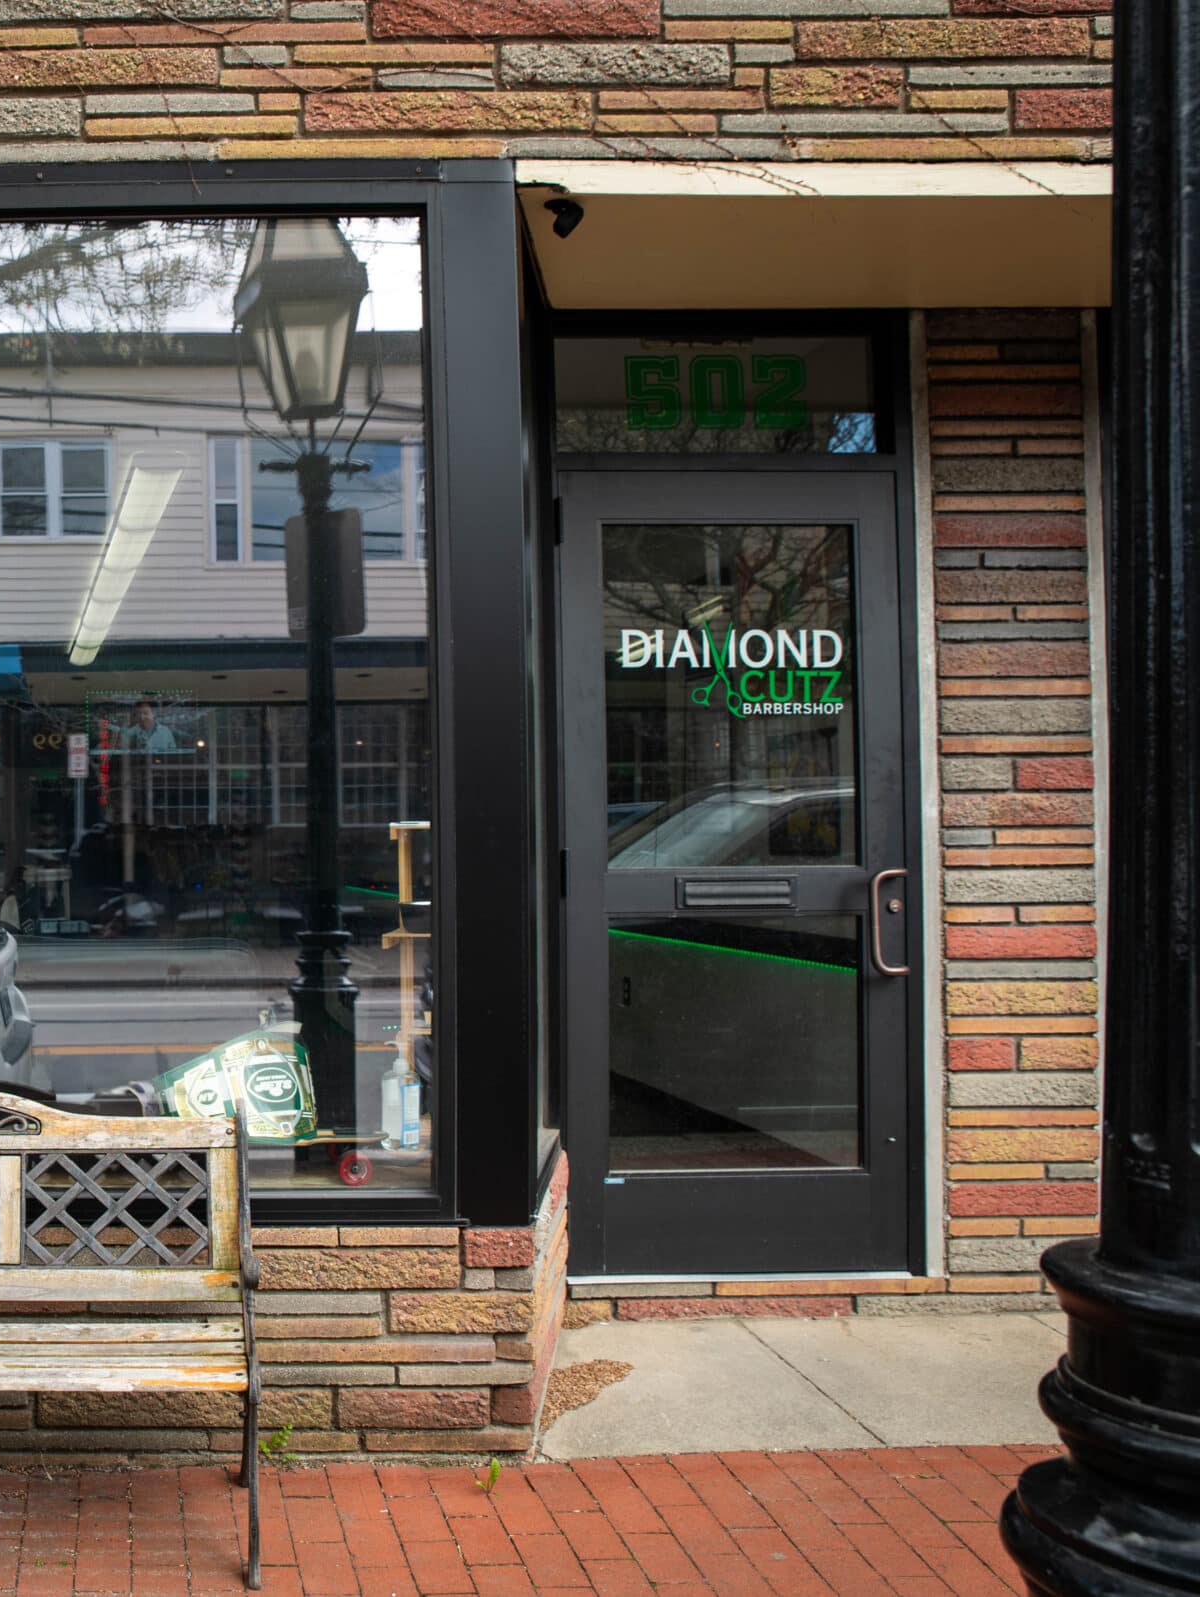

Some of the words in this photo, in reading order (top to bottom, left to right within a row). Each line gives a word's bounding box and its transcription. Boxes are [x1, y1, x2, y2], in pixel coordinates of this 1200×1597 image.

[623, 354, 809, 431] 502
[620, 629, 843, 668] DIAMOND
[739, 670, 843, 703] CUTZ
[742, 703, 844, 715] BARBERSHOP
